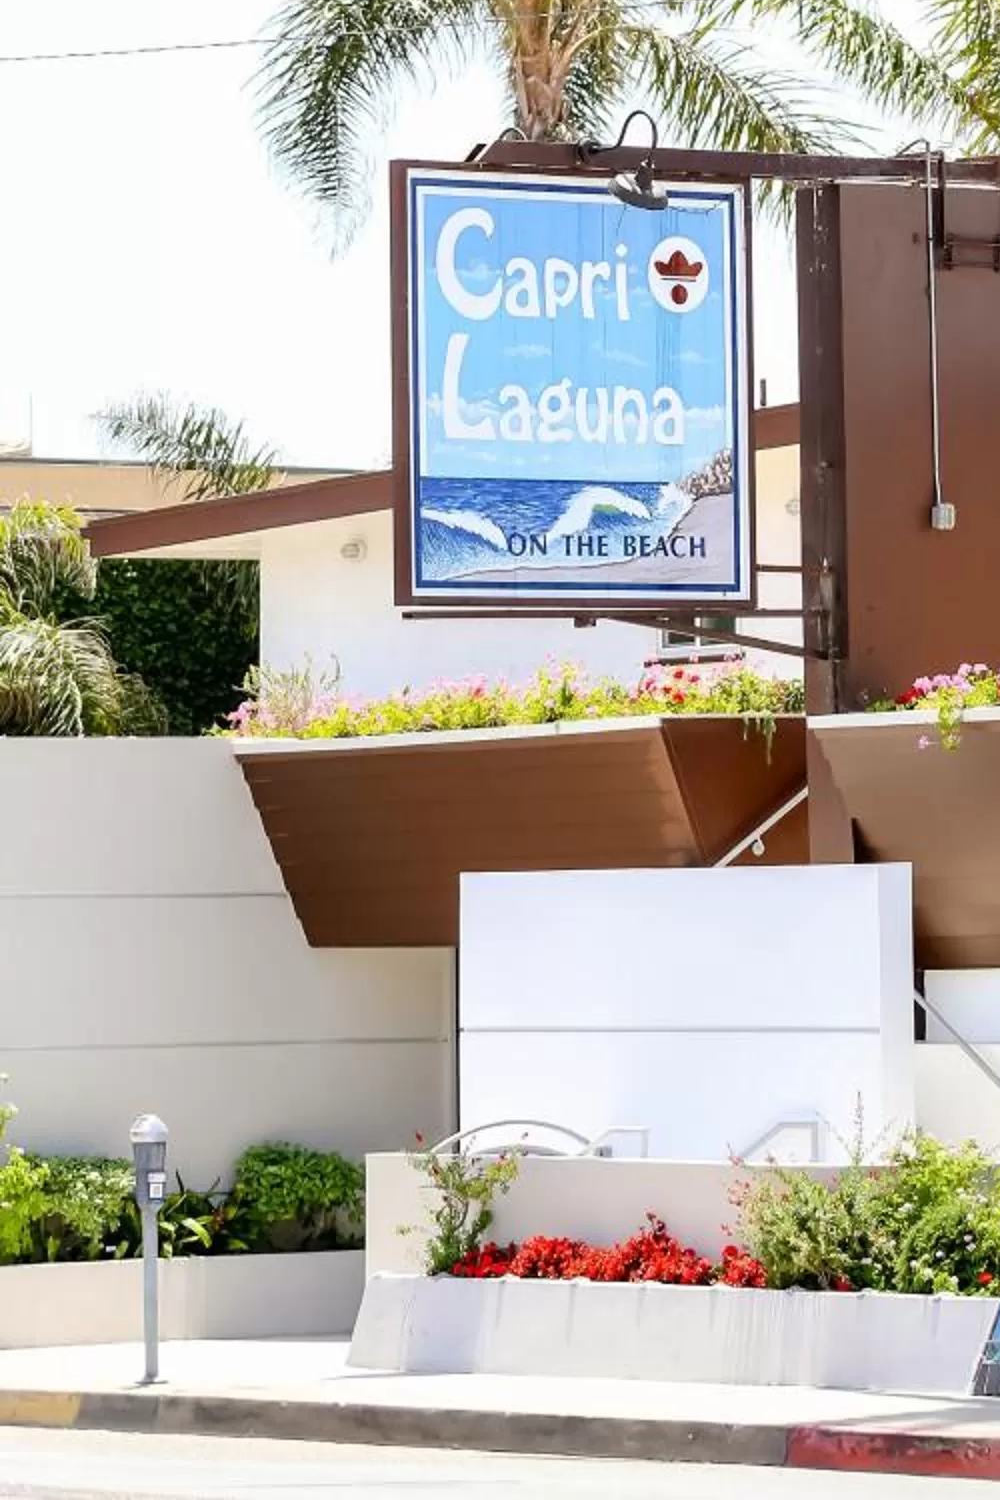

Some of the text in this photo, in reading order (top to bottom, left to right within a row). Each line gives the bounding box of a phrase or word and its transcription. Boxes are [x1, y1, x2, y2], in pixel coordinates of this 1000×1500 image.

[435, 206, 631, 321] Capri
[442, 332, 687, 445] Laguna
[508, 532, 707, 558] ON THE BEACH
